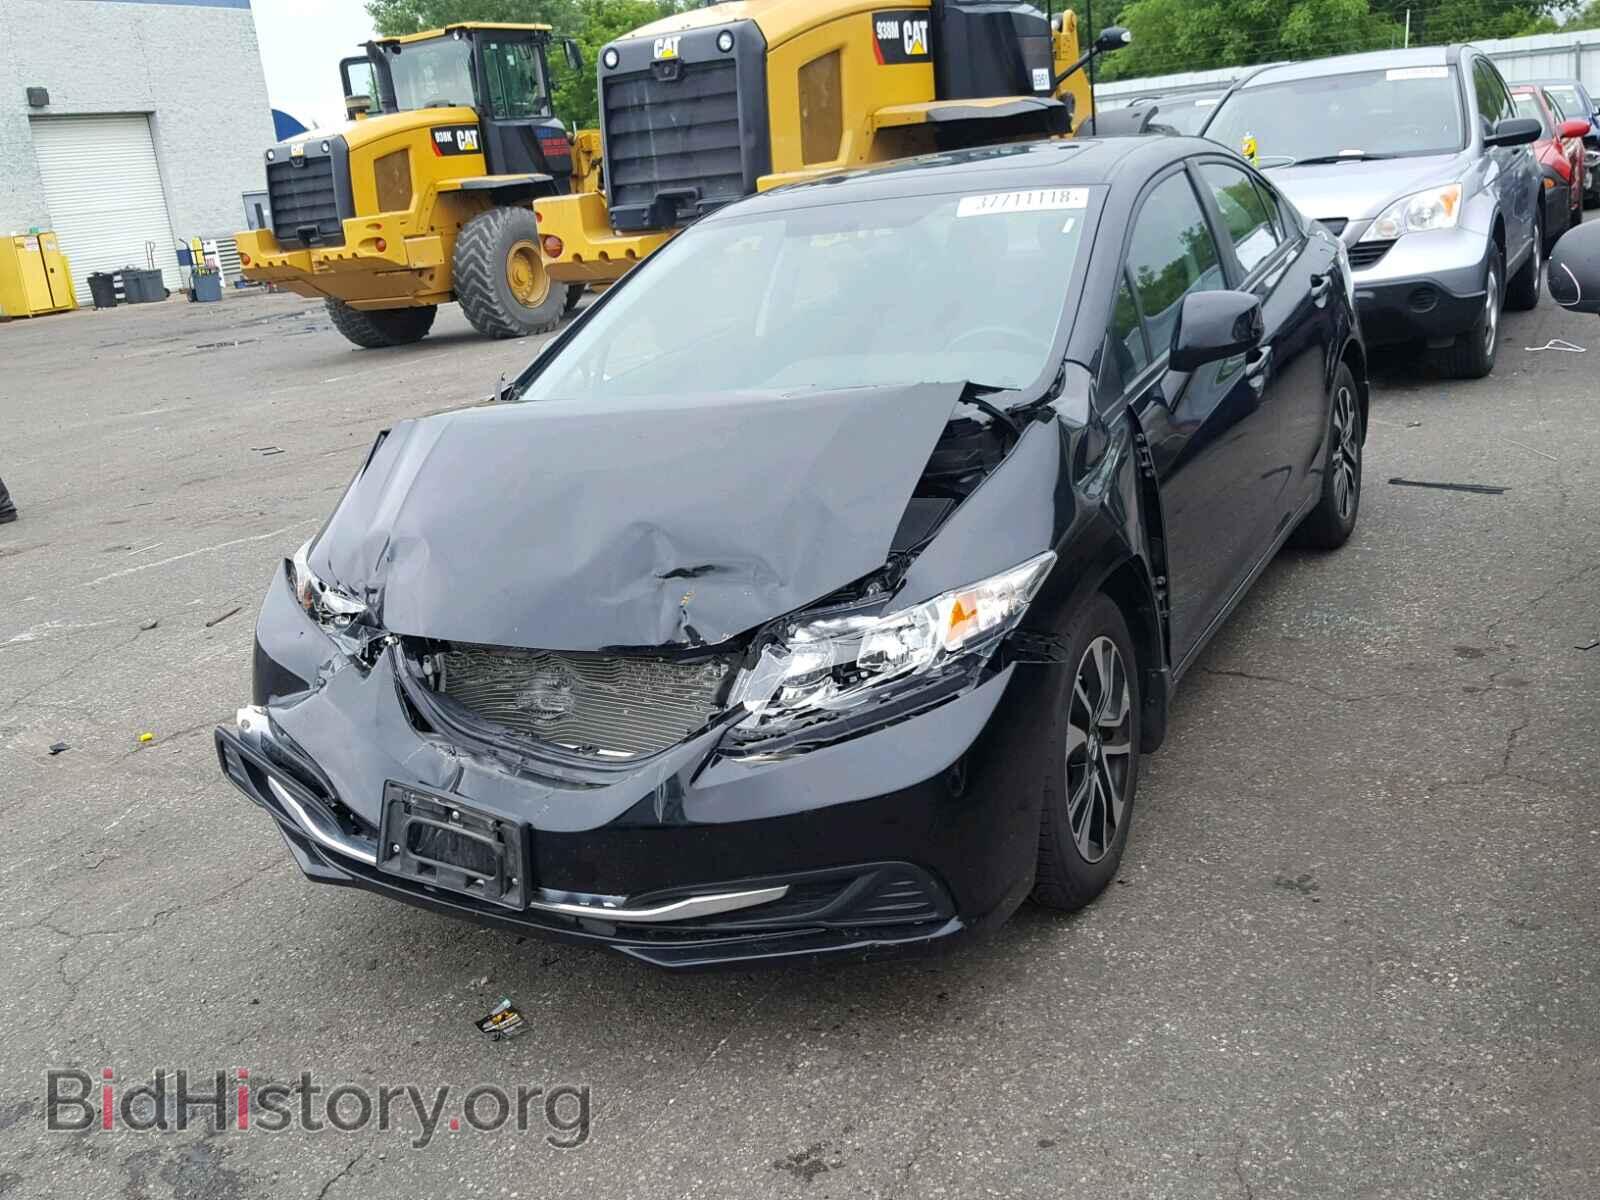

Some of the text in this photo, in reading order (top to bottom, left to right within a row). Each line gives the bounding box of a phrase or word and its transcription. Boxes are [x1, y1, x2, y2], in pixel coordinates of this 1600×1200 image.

[653, 36, 681, 60] CAT
[876, 19, 928, 55] 938M CAT
[456, 129, 479, 151] CAT
